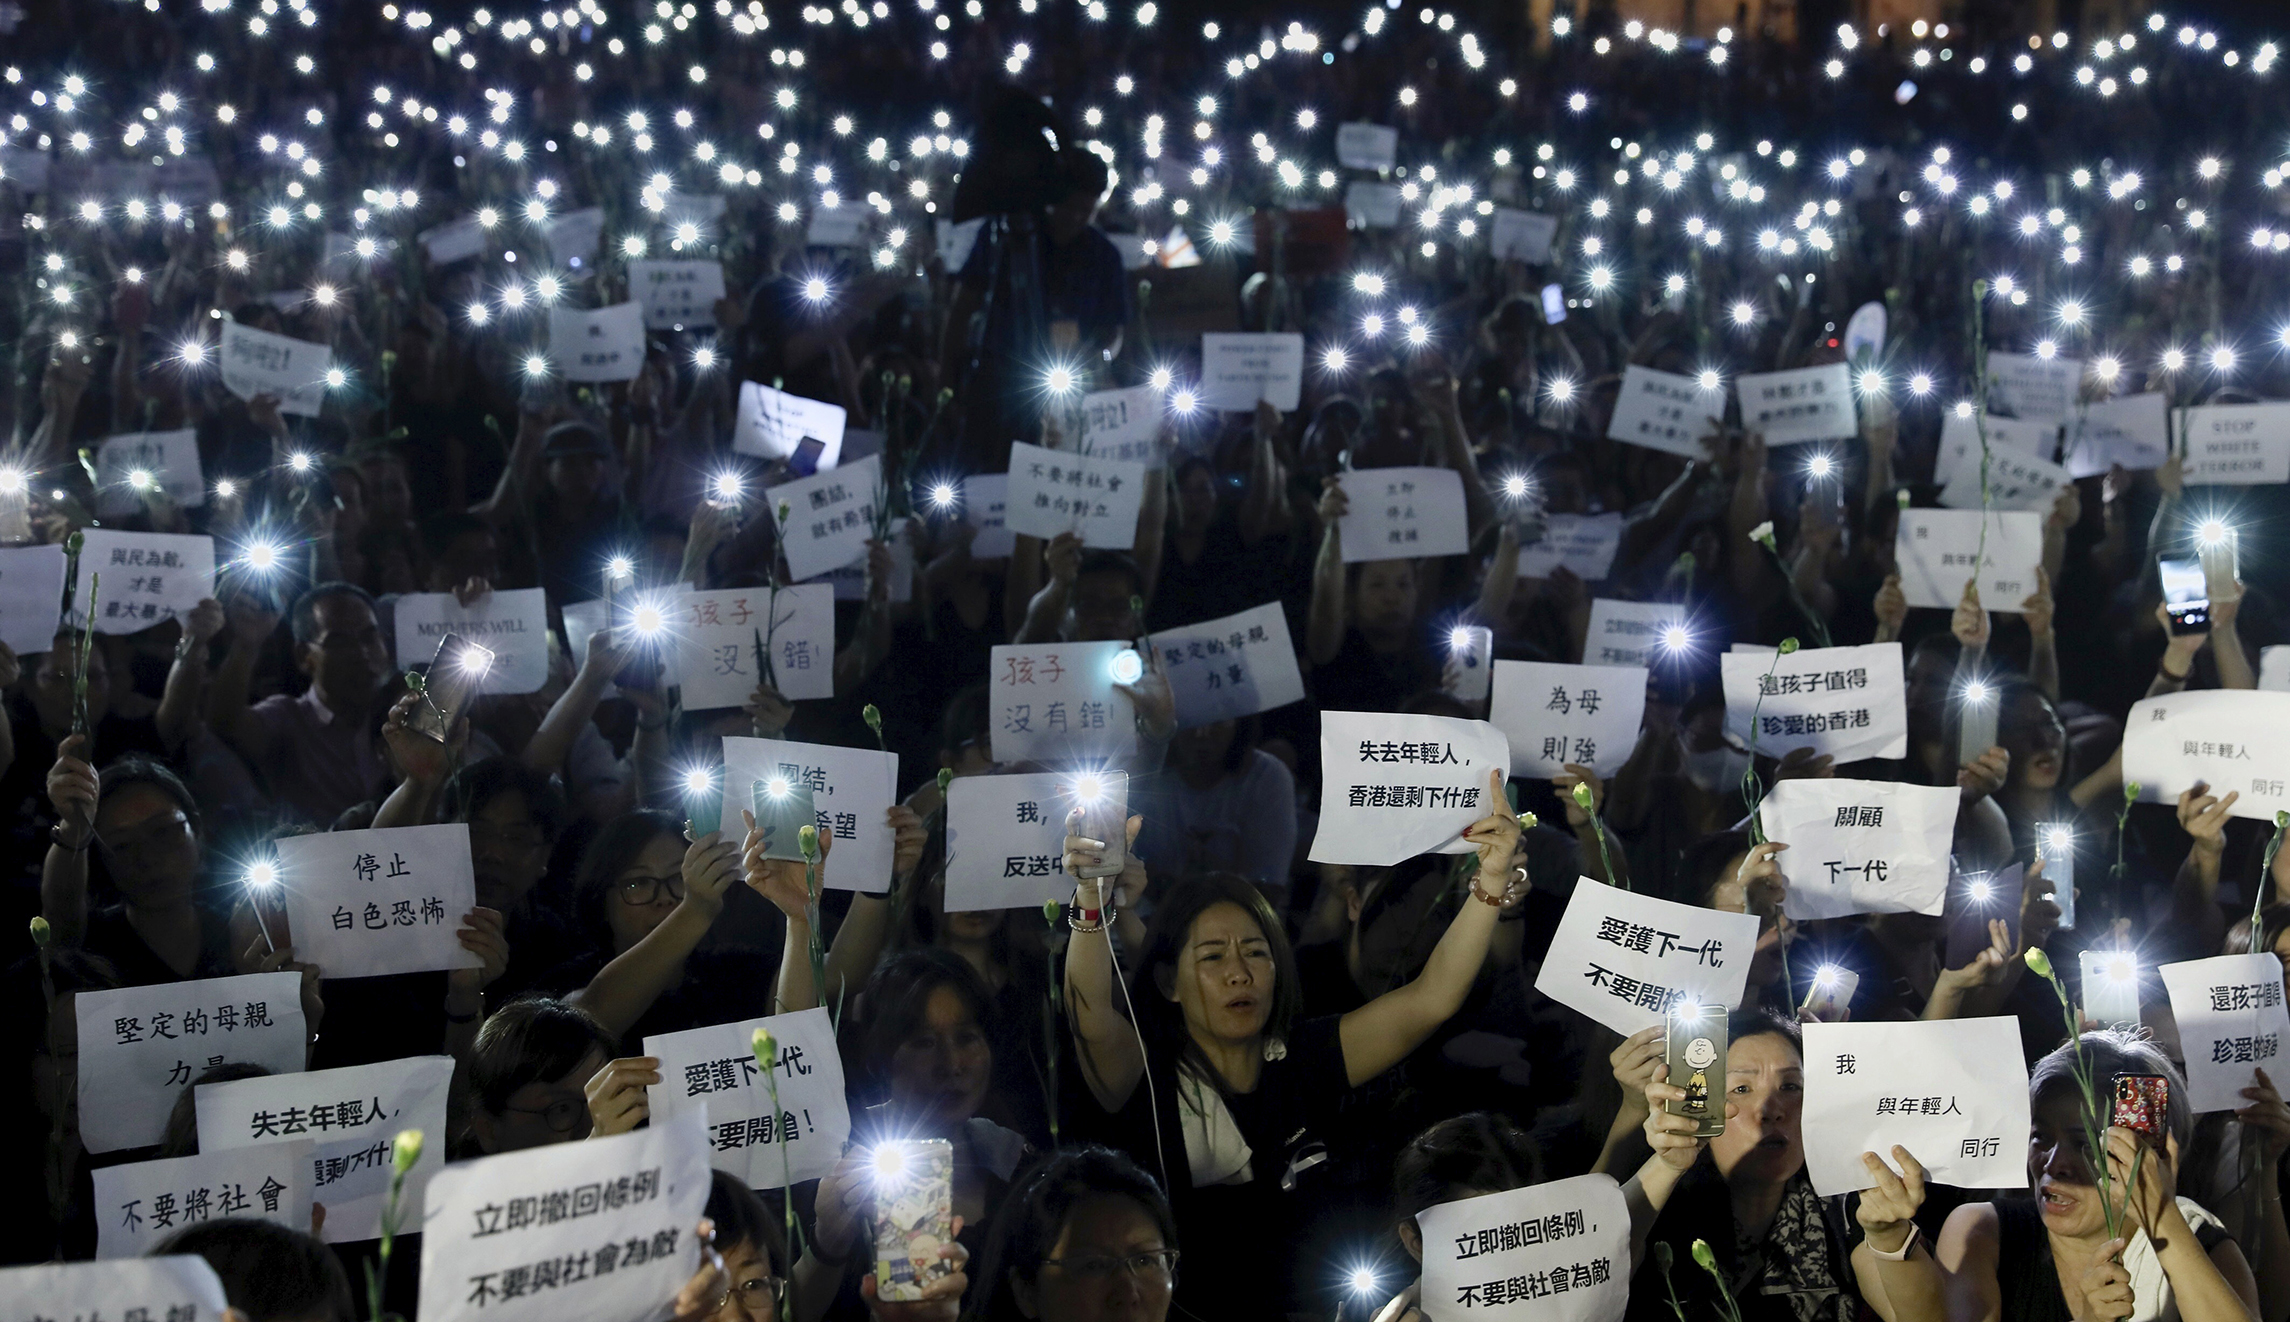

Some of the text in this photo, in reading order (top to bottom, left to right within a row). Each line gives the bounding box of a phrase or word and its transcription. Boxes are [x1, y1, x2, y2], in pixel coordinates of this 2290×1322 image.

[2213, 419, 2255, 433] STOP
[2206, 441, 2260, 453] WHITE
[1029, 462, 1124, 492] 不要將社會
[2200, 459, 2265, 473] TERROR
[130, 576, 164, 595] 才是
[105, 602, 177, 621] 最大暴力
[489, 618, 527, 633] WILL
[1164, 624, 1269, 667] 堅定的母親
[1000, 654, 1066, 687] 孩子
[1206, 669, 1244, 690] 力量
[1758, 667, 1868, 696] 還孩子值得
[1545, 685, 1602, 716] 為母
[1762, 709, 1872, 736] 珍愛的香港
[2151, 707, 2166, 722] 我
[1358, 740, 1470, 767] 失去年輕人,
[1540, 735, 1598, 767] 則強
[2183, 739, 2252, 761] 與年輕人
[1348, 784, 1481, 811] 香港還剩下什麼
[2251, 777, 2285, 798] 同行
[1016, 800, 1048, 827] 我,
[1835, 804, 1884, 829] 關顧
[352, 851, 412, 882] 停止
[1822, 859, 1889, 885] 下一代
[330, 896, 446, 932] 白色恐怖
[1596, 916, 1726, 969] 愛護下一代,
[114, 1000, 275, 1046] 堅定的母親
[1835, 1053, 1857, 1076] 我
[250, 1095, 402, 1140] 失去年輕人,
[1876, 1096, 1964, 1118] 與年輕人
[1958, 1136, 2002, 1159] 同行
[121, 1173, 288, 1235] 不要將社會
[470, 1164, 677, 1240] 立即撤回條例,
[1454, 1207, 1600, 1262] 立即撤回條例,
[466, 1224, 683, 1309] 不要與社會為敵
[1455, 1255, 1613, 1310] 不要與社會為敵
